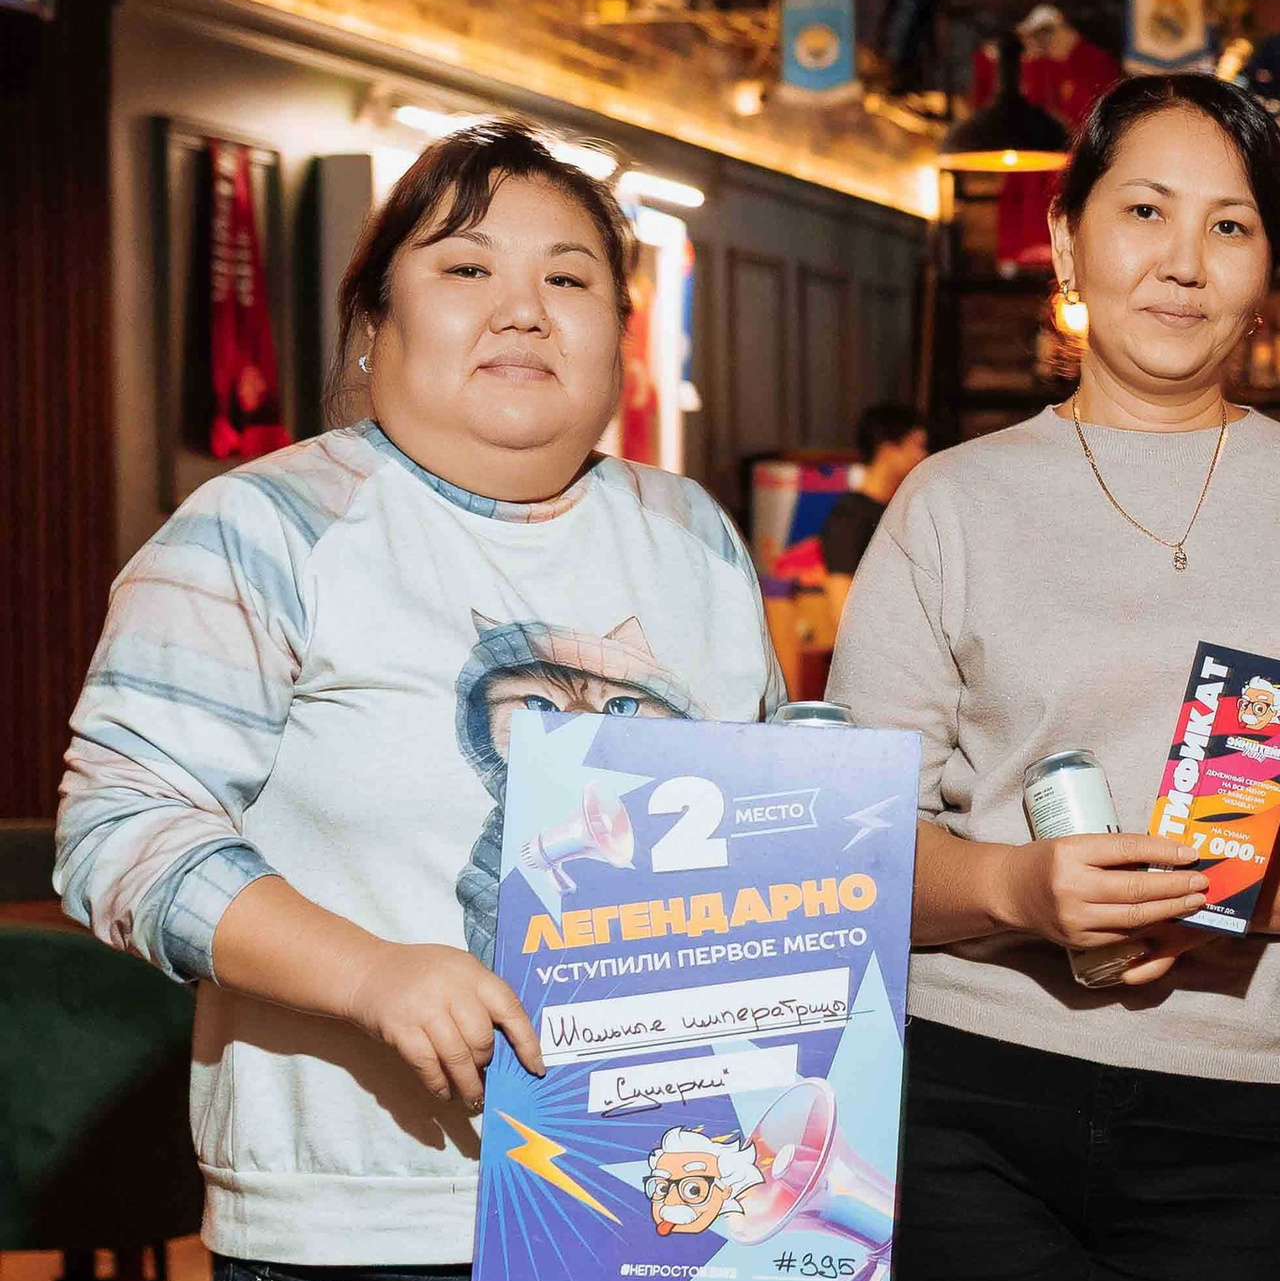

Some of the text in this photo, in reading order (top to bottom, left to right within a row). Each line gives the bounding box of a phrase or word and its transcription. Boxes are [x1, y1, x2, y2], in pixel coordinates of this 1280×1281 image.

[1158, 655, 1229, 839] ТИФИКАТ
[648, 776, 805, 873] 2 МЕСТО
[1212, 827, 1250, 840] НА СУММУ
[522, 873, 877, 954] ЛЕГЕНДАРНО
[537, 927, 868, 984] УСТУПИЛИ ПЕРВОЕ МЕСТО
[773, 1251, 856, 1279] #395
